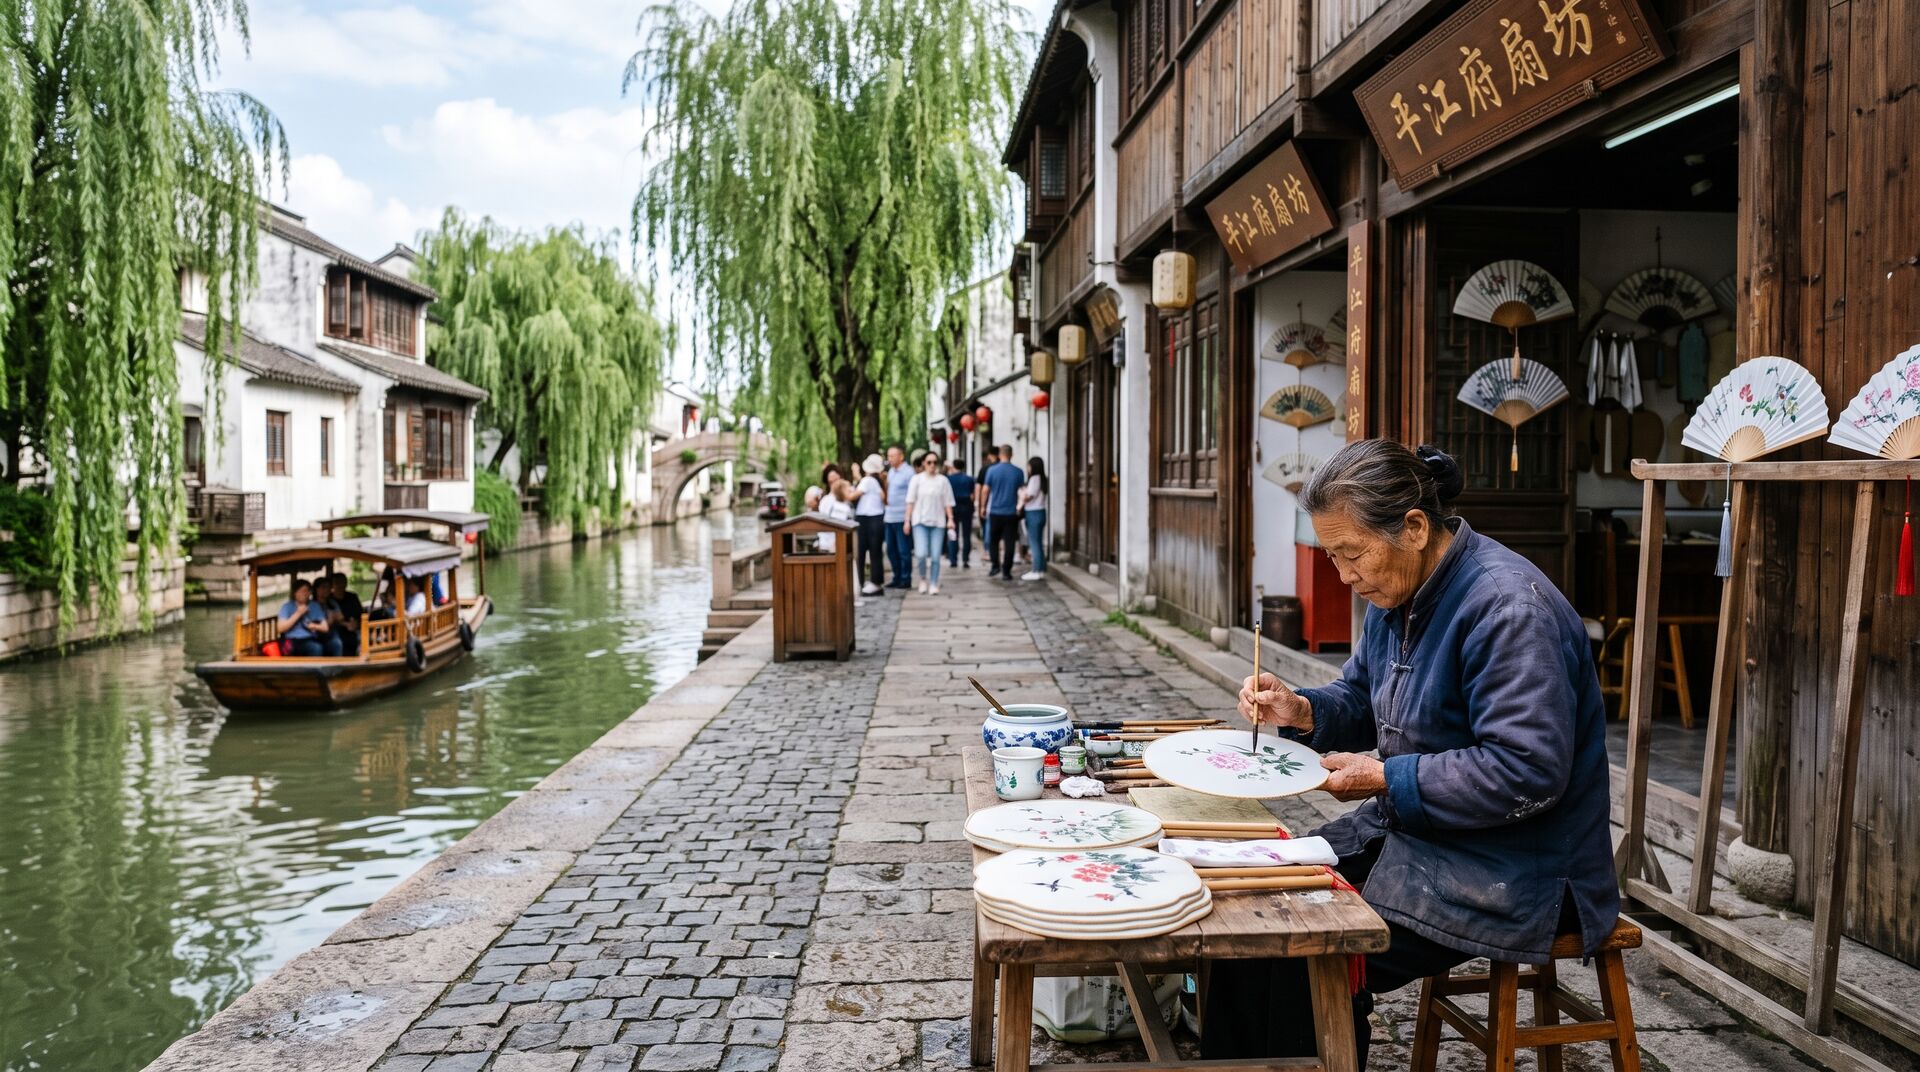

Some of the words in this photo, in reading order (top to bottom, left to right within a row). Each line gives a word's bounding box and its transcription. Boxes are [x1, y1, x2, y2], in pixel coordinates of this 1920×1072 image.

[1390, 0, 1592, 156] 平江府扇坊
[1222, 173, 1310, 254] 平江府扇坊
